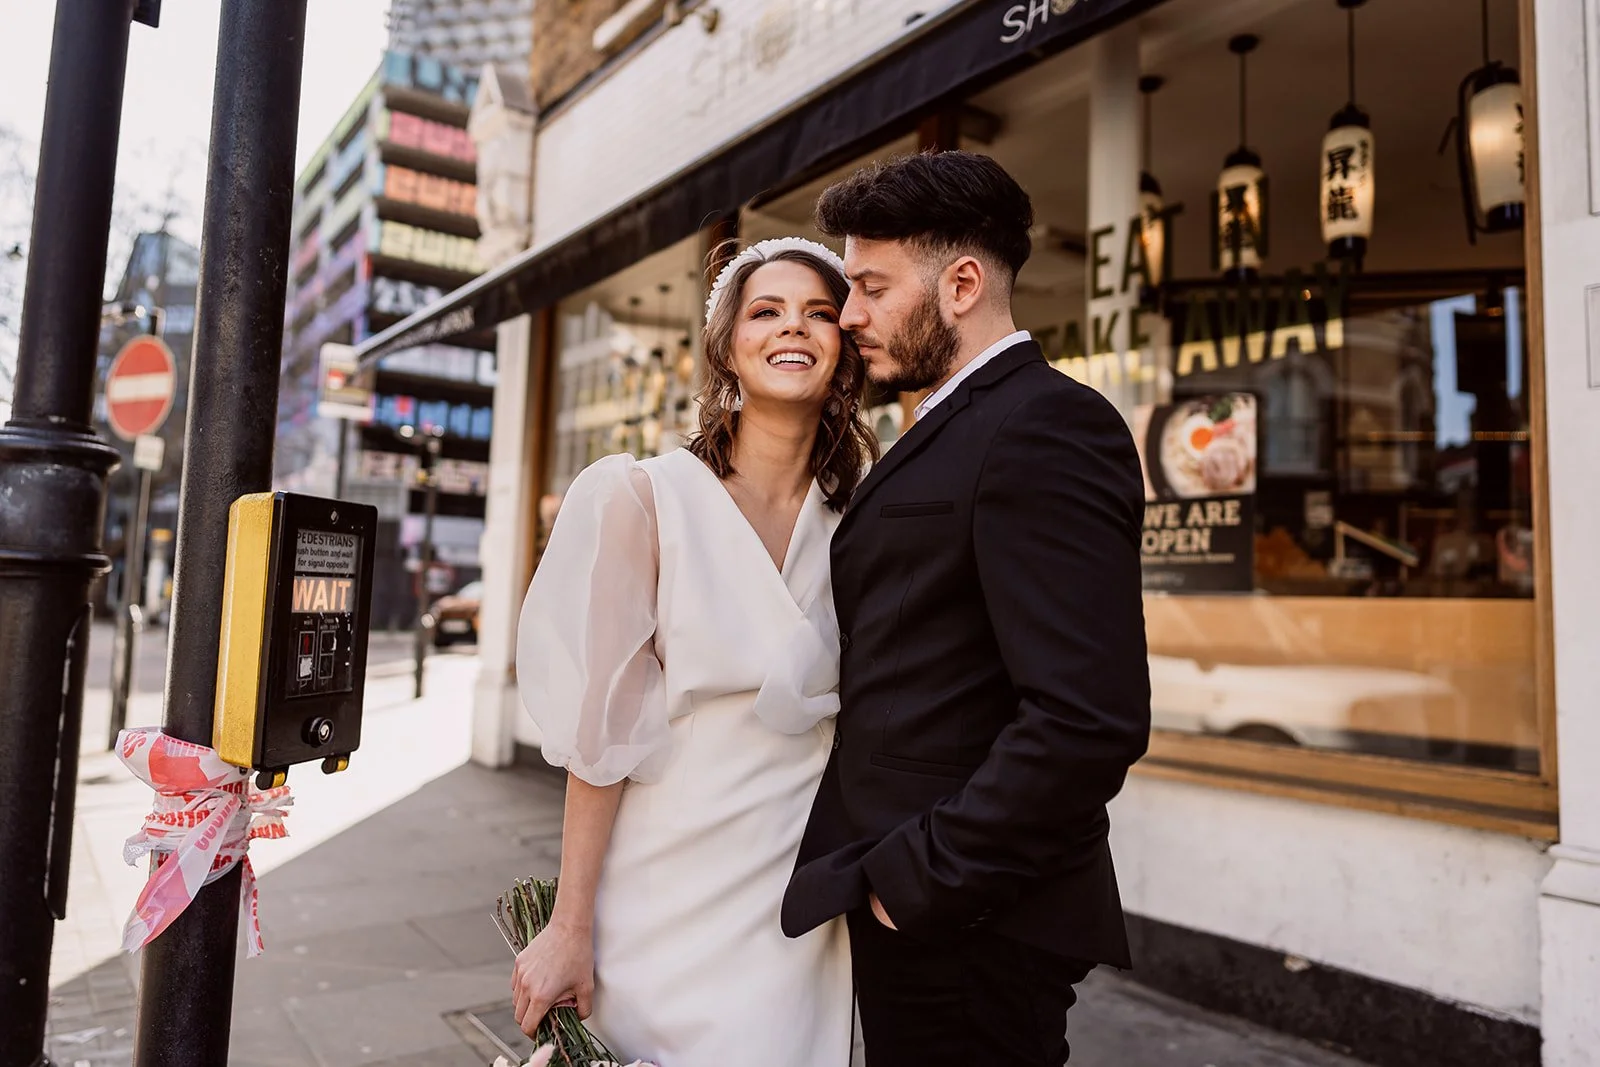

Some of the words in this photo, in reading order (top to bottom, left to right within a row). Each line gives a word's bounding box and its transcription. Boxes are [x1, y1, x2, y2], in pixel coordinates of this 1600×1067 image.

[1091, 202, 1185, 298] EAT
[1176, 259, 1352, 378] AWAY
[1143, 503, 1181, 528] WE
[1186, 500, 1241, 526] ARE
[297, 532, 354, 548] PEDESTRIANS
[310, 547, 329, 556] button
[330, 550, 341, 558] and
[1141, 528, 1212, 554] OPEN
[298, 557, 307, 567] for
[308, 558, 325, 569] signal
[326, 561, 350, 570] opposite
[293, 578, 352, 611] WAIT
